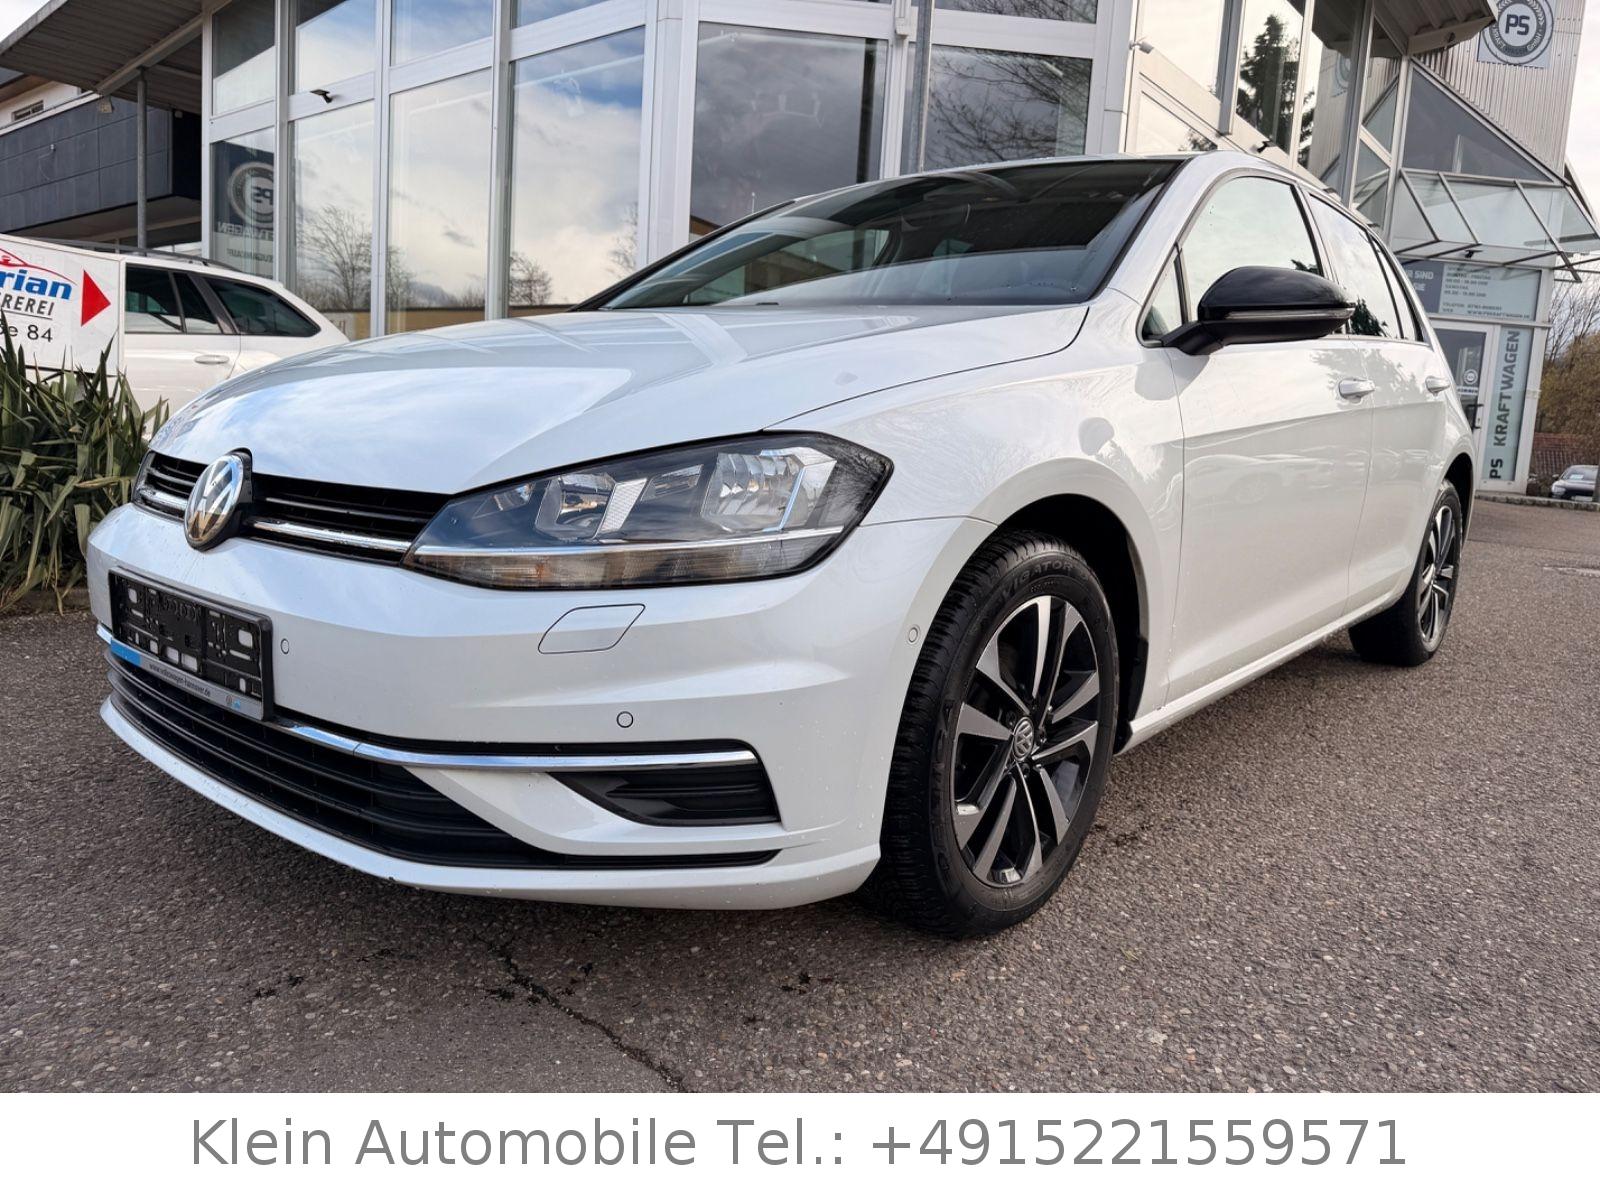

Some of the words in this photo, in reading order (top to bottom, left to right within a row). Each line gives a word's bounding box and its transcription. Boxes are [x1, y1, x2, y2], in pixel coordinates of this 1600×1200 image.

[1505, 14, 1530, 35] PS
[0, 268, 73, 300] rian
[0, 292, 55, 316] REREI
[27, 324, 53, 343] 84
[1493, 330, 1520, 447] KRAFTWAGEN
[1489, 458, 1503, 479] PS
